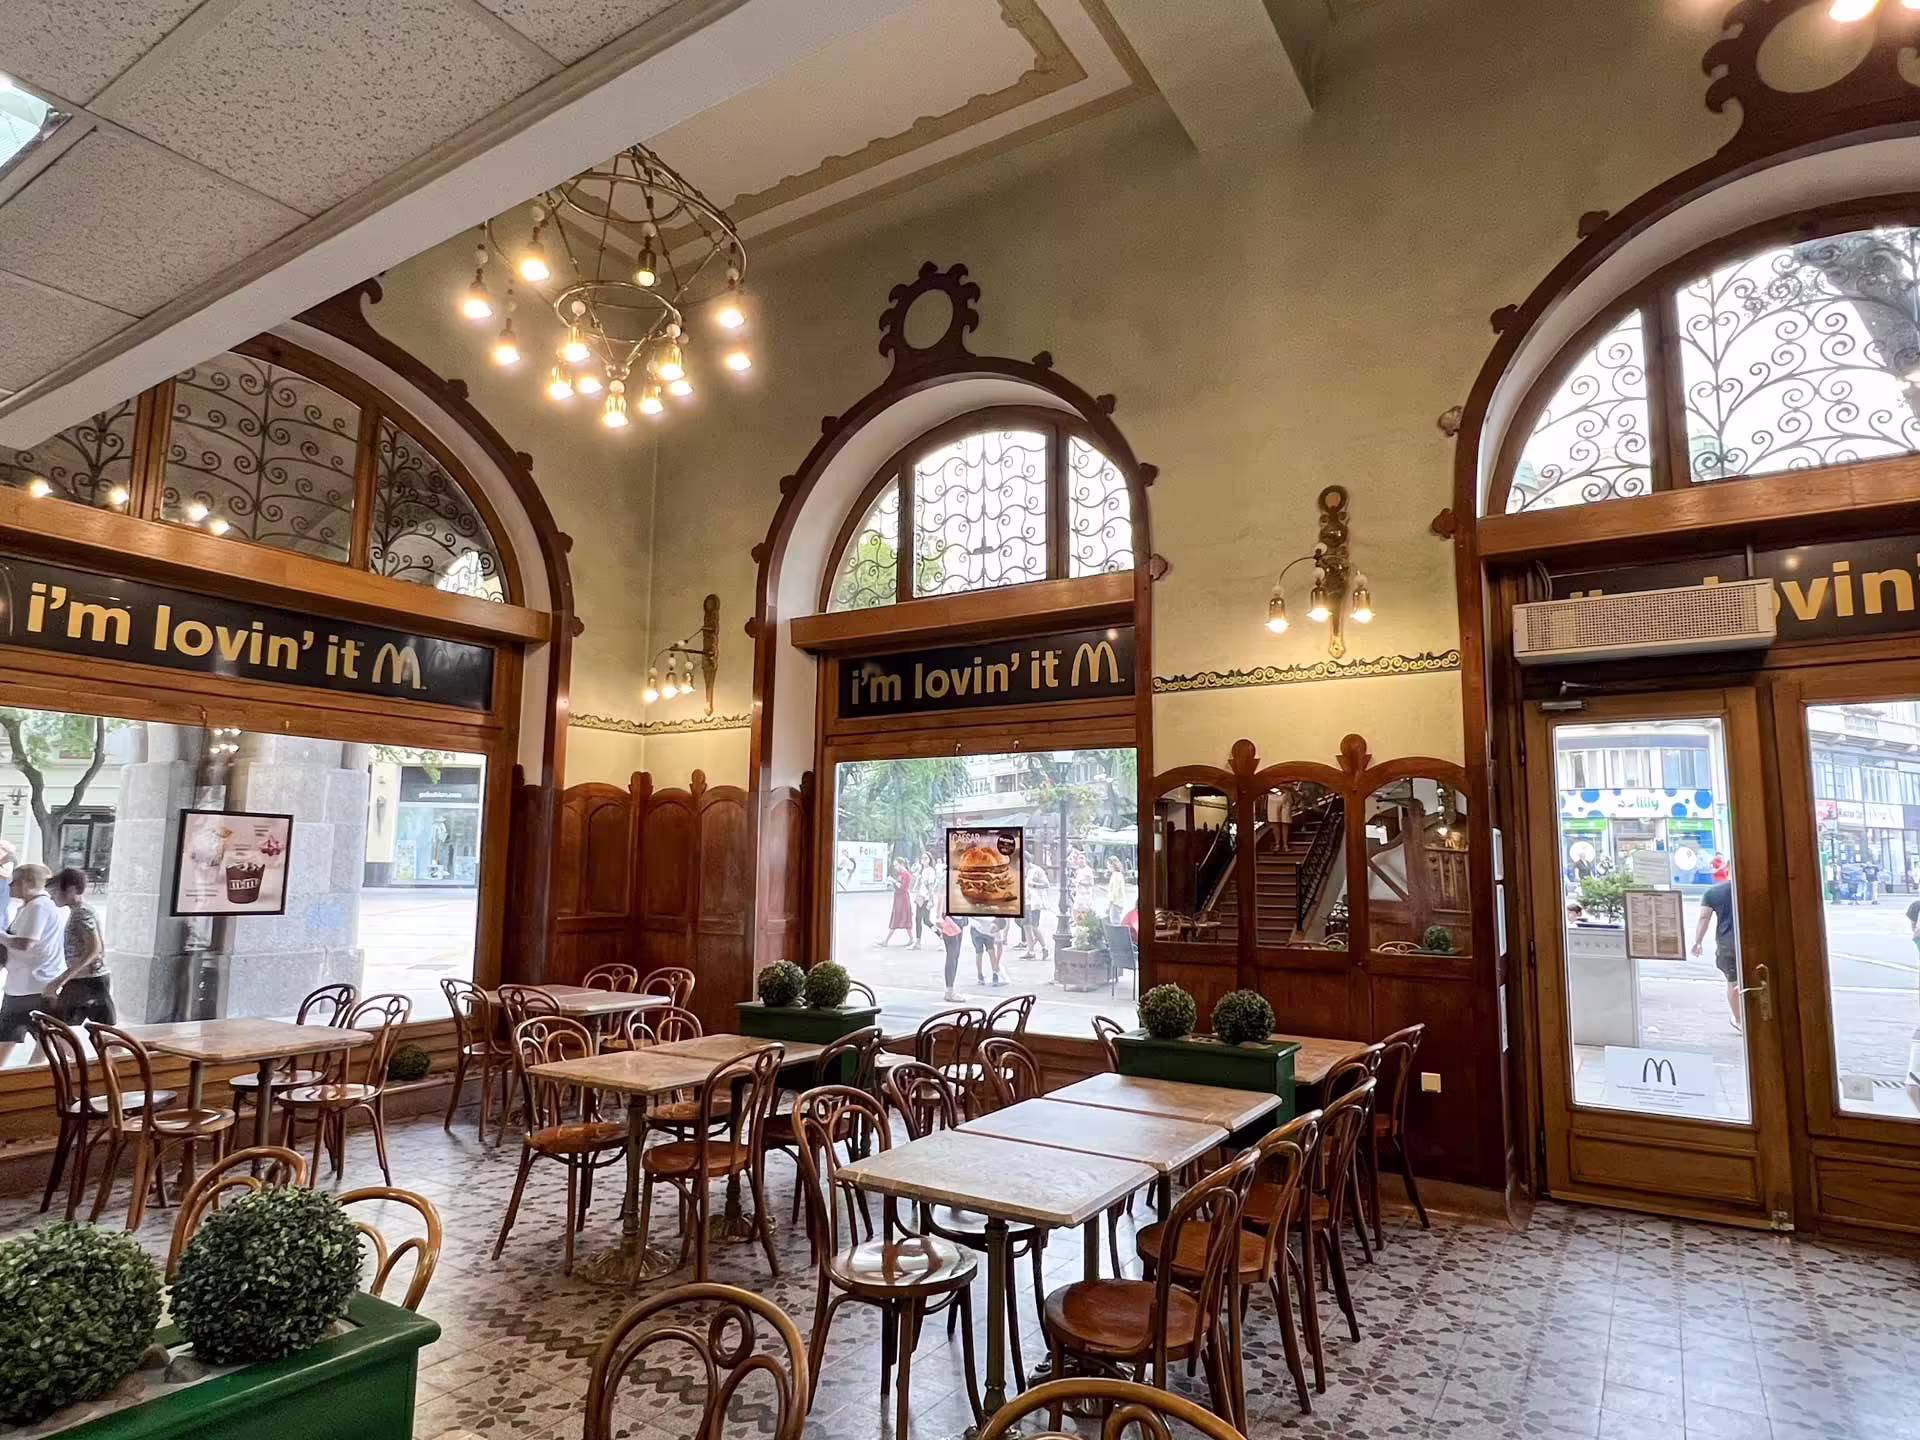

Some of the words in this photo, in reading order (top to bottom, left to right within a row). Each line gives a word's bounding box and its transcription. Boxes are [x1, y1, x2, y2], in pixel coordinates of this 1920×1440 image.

[26, 582, 132, 646] i'm
[153, 604, 315, 671] lovin'
[325, 634, 361, 680] it
[851, 669, 902, 705] i'm
[914, 652, 1020, 699] lovin'
[1031, 650, 1059, 689] it
[952, 833, 981, 843] CAESAR
